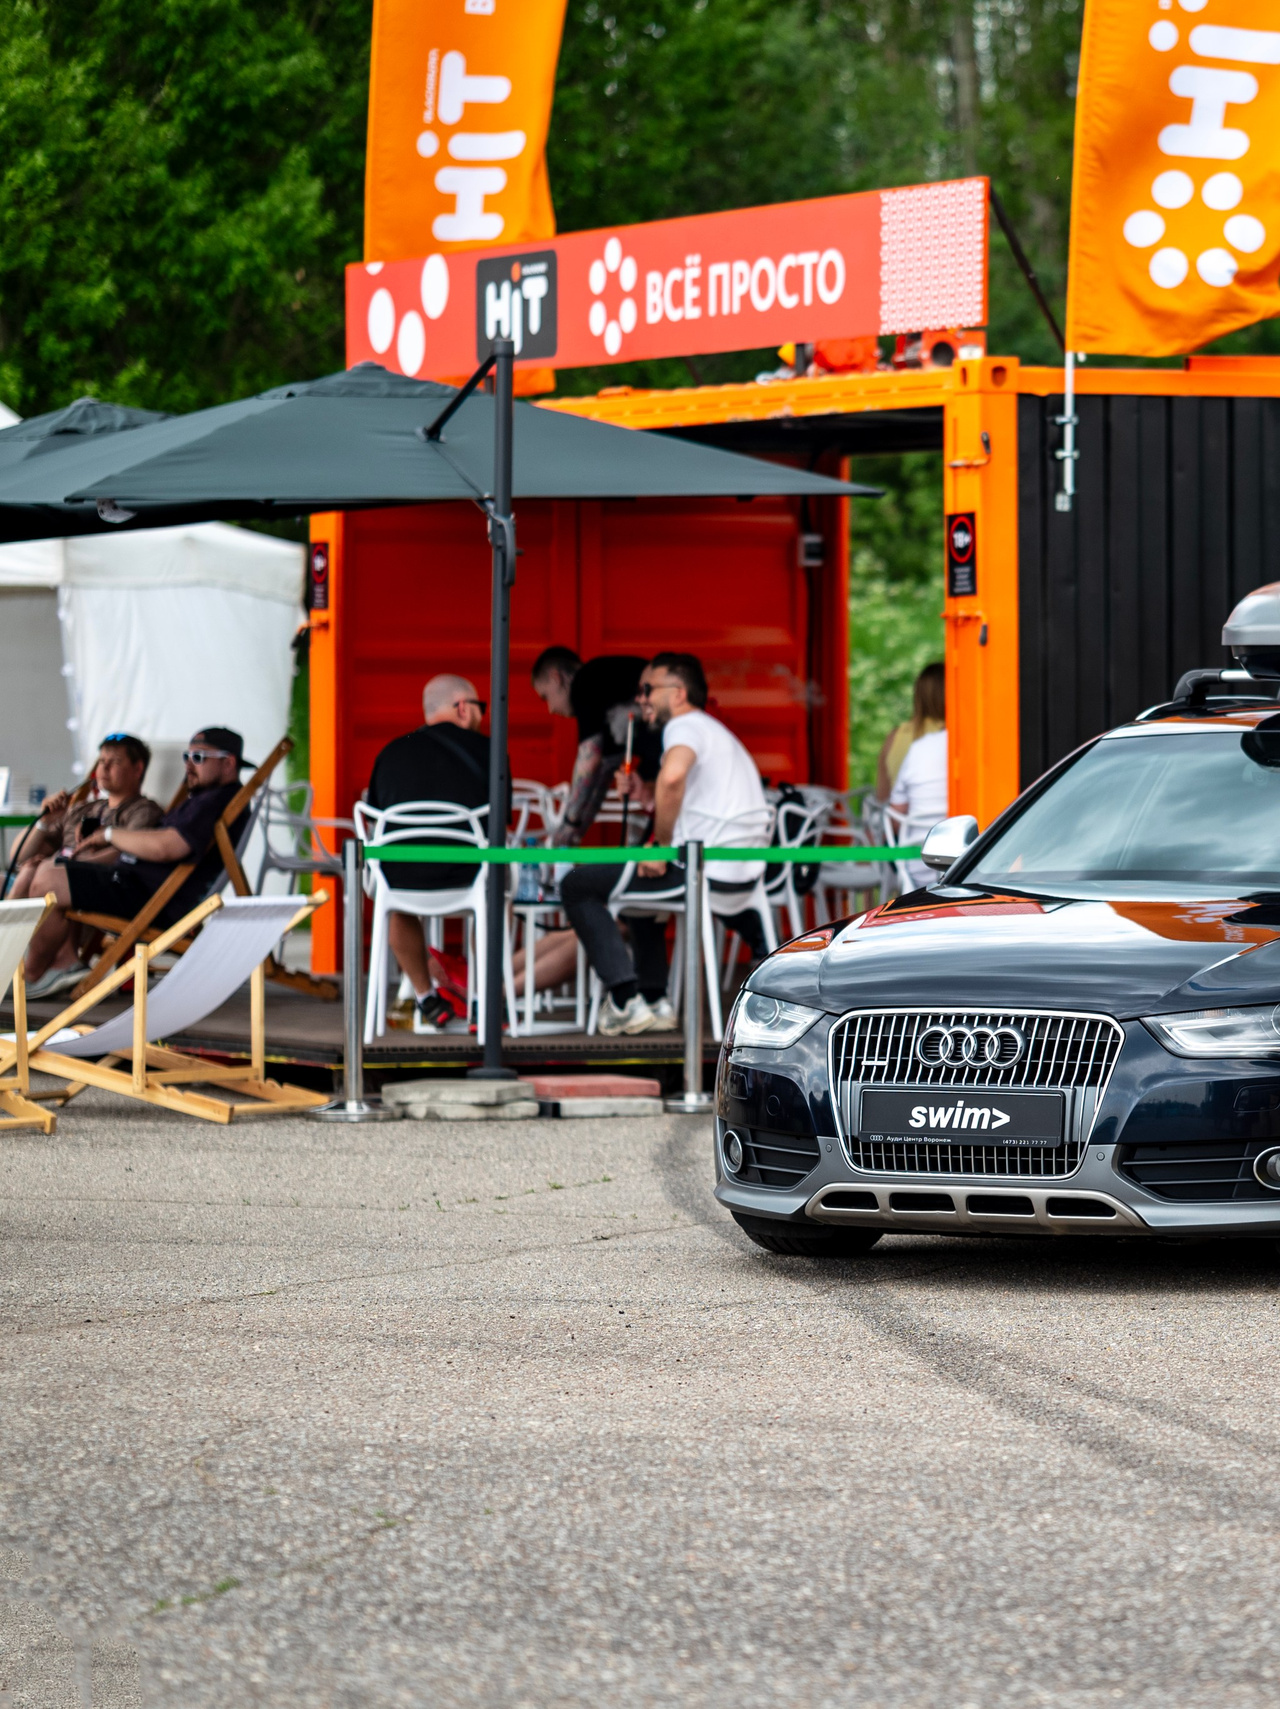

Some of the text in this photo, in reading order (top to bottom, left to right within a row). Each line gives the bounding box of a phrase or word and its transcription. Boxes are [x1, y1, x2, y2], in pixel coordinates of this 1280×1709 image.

[645, 247, 846, 325] ВСЁ ПРОСТО
[886, 1135, 903, 1143] Ауди
